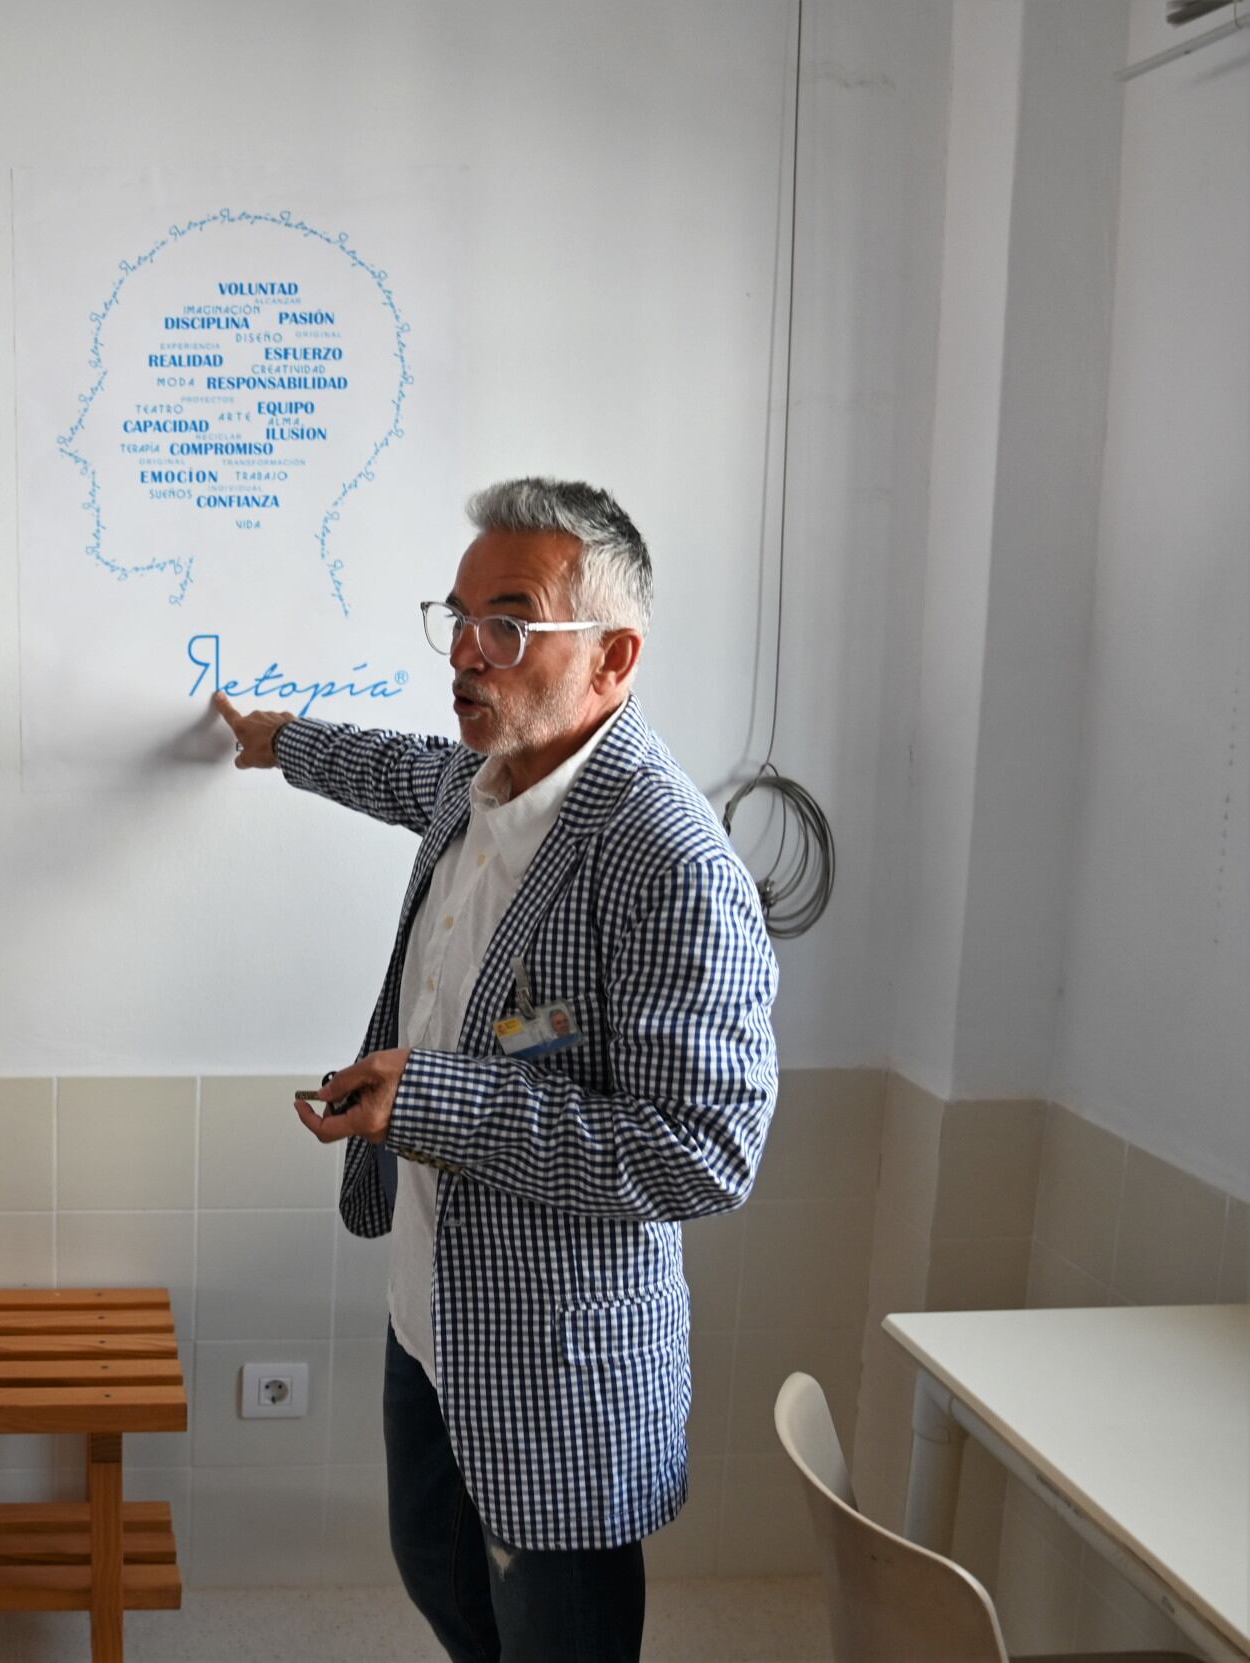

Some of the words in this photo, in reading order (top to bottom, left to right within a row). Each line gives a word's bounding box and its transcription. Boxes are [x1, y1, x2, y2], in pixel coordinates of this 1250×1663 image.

[218, 282, 298, 295] VOLUNTAD
[183, 304, 261, 315] IMAGINACIÓN
[164, 316, 250, 330] DISCIPLINA
[278, 309, 335, 325] PASIÓN
[235, 331, 283, 343] DISEÑO
[264, 347, 343, 361] ESFUERZO
[148, 354, 224, 368] REALIDAD
[251, 364, 326, 375] CREATIVIDAD
[157, 377, 195, 388] MODA
[206, 376, 348, 390] RESPONSABILIDAD
[136, 404, 183, 415] TEATRO
[257, 401, 315, 415] EQUIPO
[218, 412, 251, 422] ARTE
[268, 417, 301, 426] ALMA
[123, 419, 210, 433] CAPACIDAD
[169, 442, 274, 456] COMPROMISO
[235, 471, 288, 481] TRABAJO
[149, 488, 193, 500] SUEÑOS
[196, 495, 280, 508] CONFIANZA
[236, 520, 261, 529] VIDA
